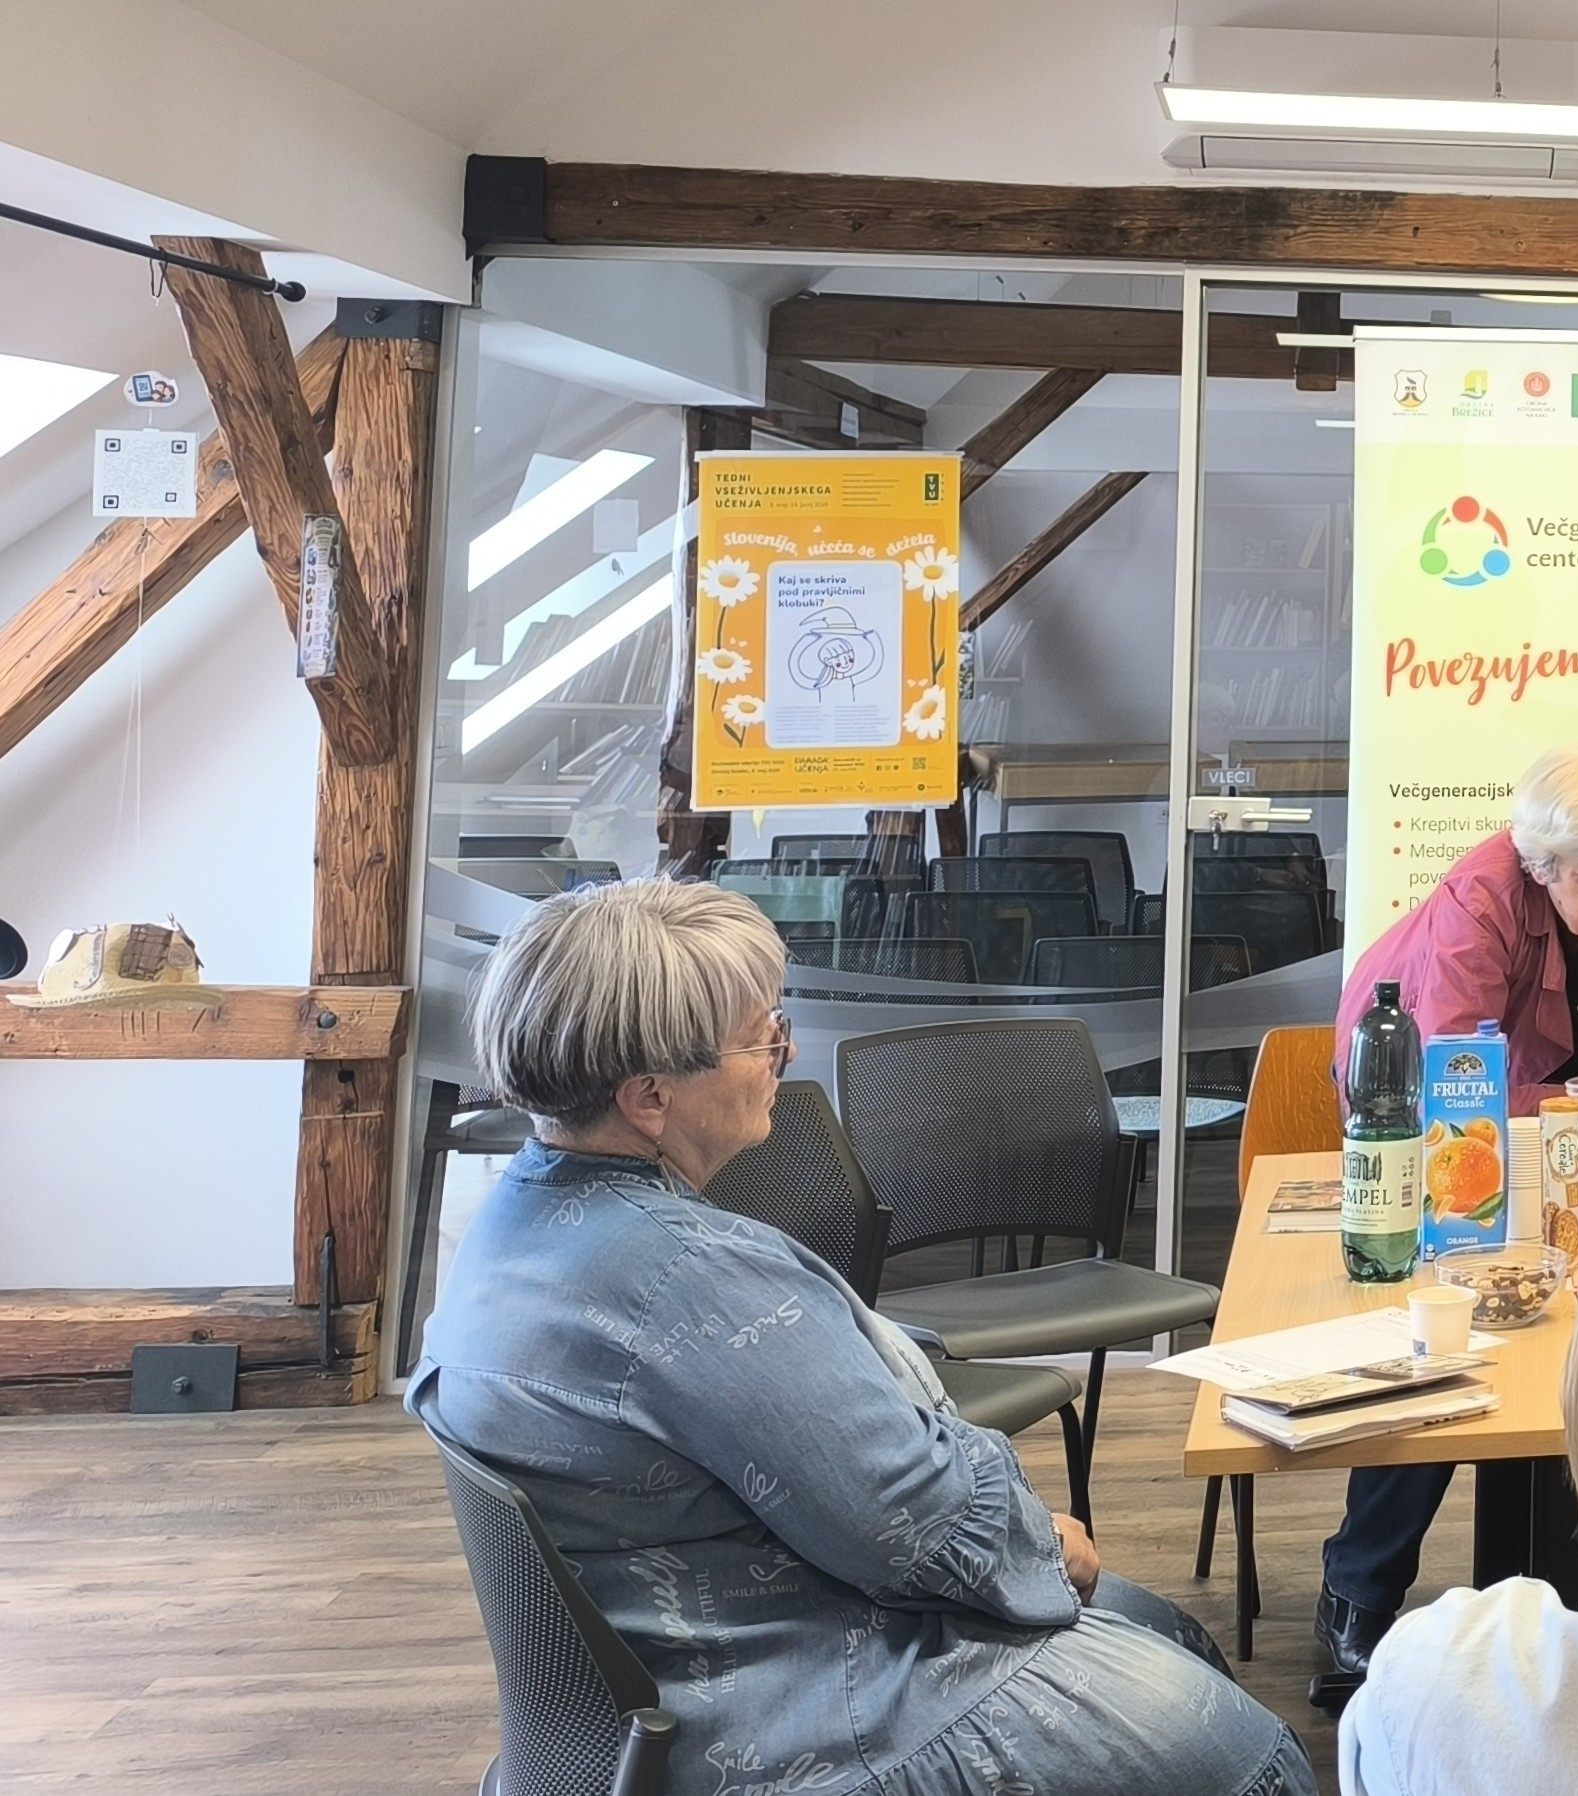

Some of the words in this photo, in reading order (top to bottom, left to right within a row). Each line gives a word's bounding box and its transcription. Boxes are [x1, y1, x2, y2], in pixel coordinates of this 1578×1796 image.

[715, 474, 751, 482] TEDNI
[715, 485, 831, 495] VSEŽIVLJENJSKEGA
[715, 498, 762, 508] UČENJA
[778, 575, 796, 585] Kaj
[799, 576, 811, 584] se
[814, 575, 847, 584] skriva
[778, 588, 799, 597] pod
[802, 586, 866, 597] pravljičnimi
[778, 599, 825, 608] klobuki?
[1208, 771, 1250, 784] VLECI
[1389, 782, 1514, 801] Večgeneracijsk
[1410, 816, 1471, 835] Krepitvi
[1432, 1081, 1498, 1097] FRUCTAL
[1444, 1096, 1486, 1108] Classic
[1446, 1237, 1478, 1245] ORANGE
[727, 1295, 803, 1349] Smile
[685, 1653, 714, 1703] Hello
